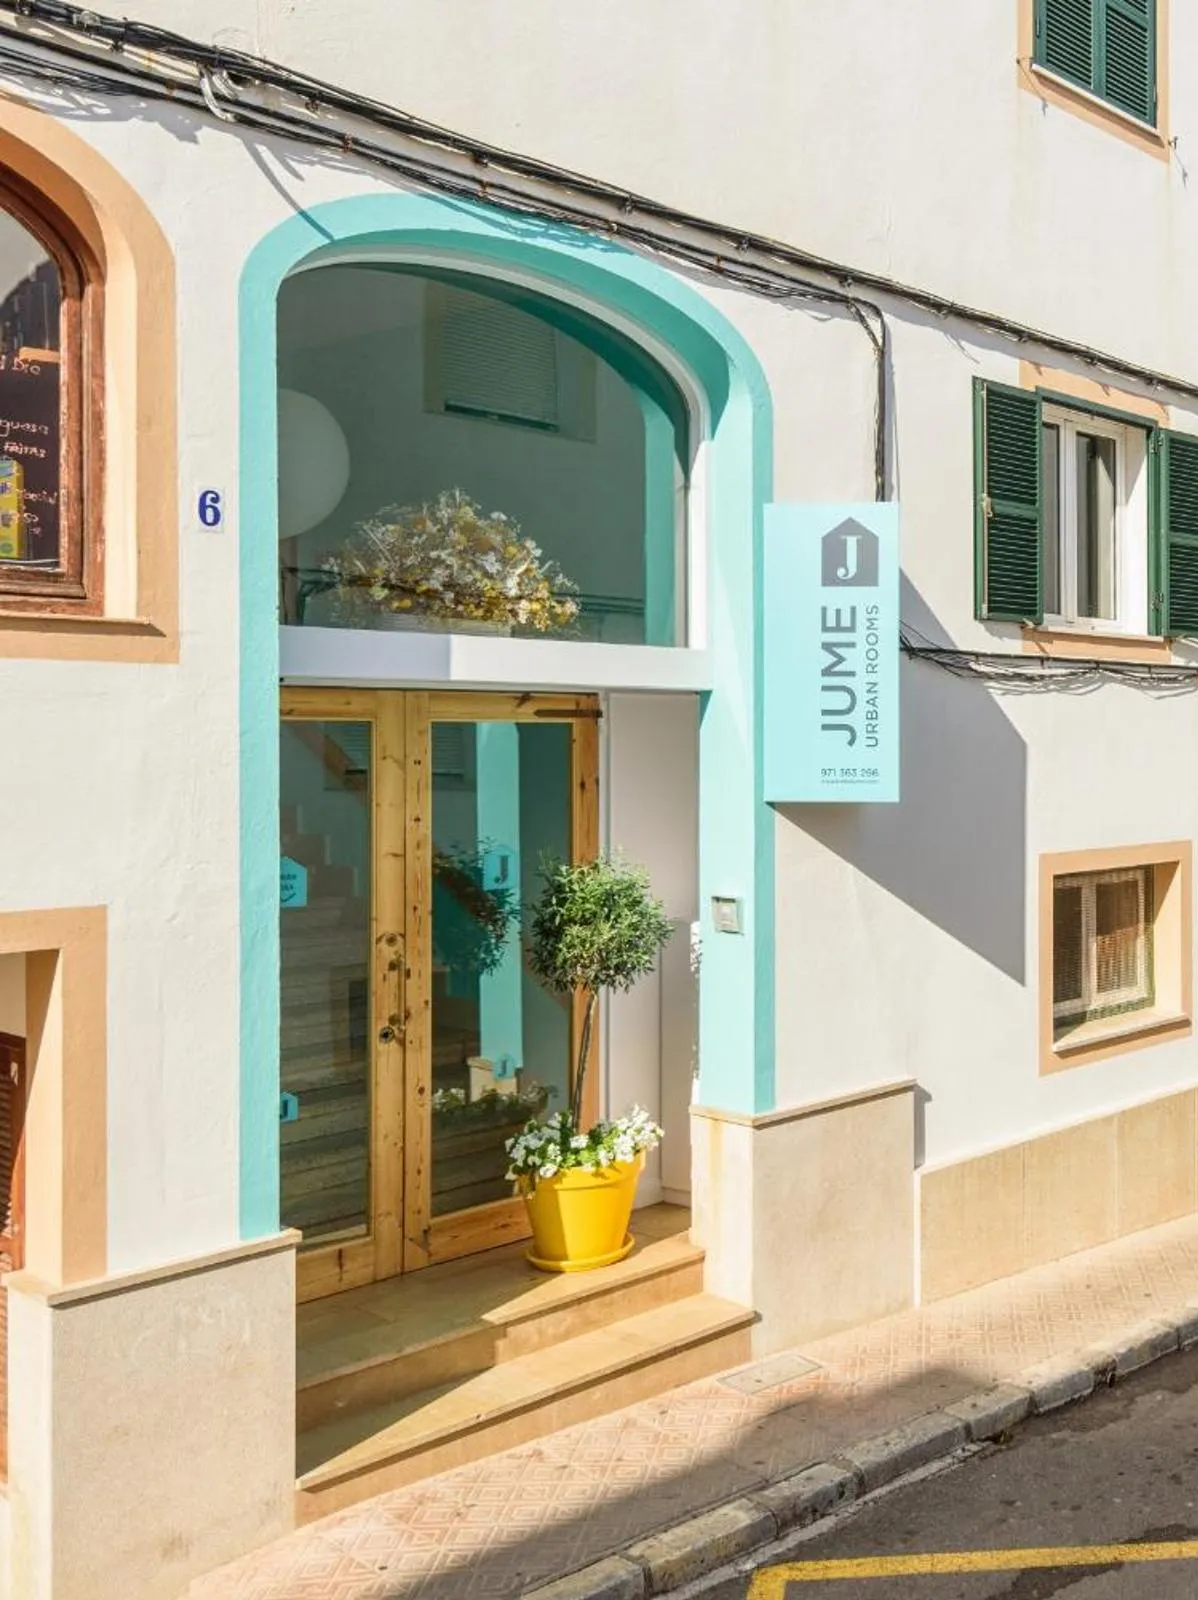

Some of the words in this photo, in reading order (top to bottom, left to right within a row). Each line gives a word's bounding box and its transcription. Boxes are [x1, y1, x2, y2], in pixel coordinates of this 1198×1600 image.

[198, 490, 222, 527] 6
[836, 534, 863, 580] J
[865, 604, 879, 674] ROOMS
[820, 605, 857, 747] JUME
[865, 681, 879, 748] URBAN
[820, 767, 837, 778] 971
